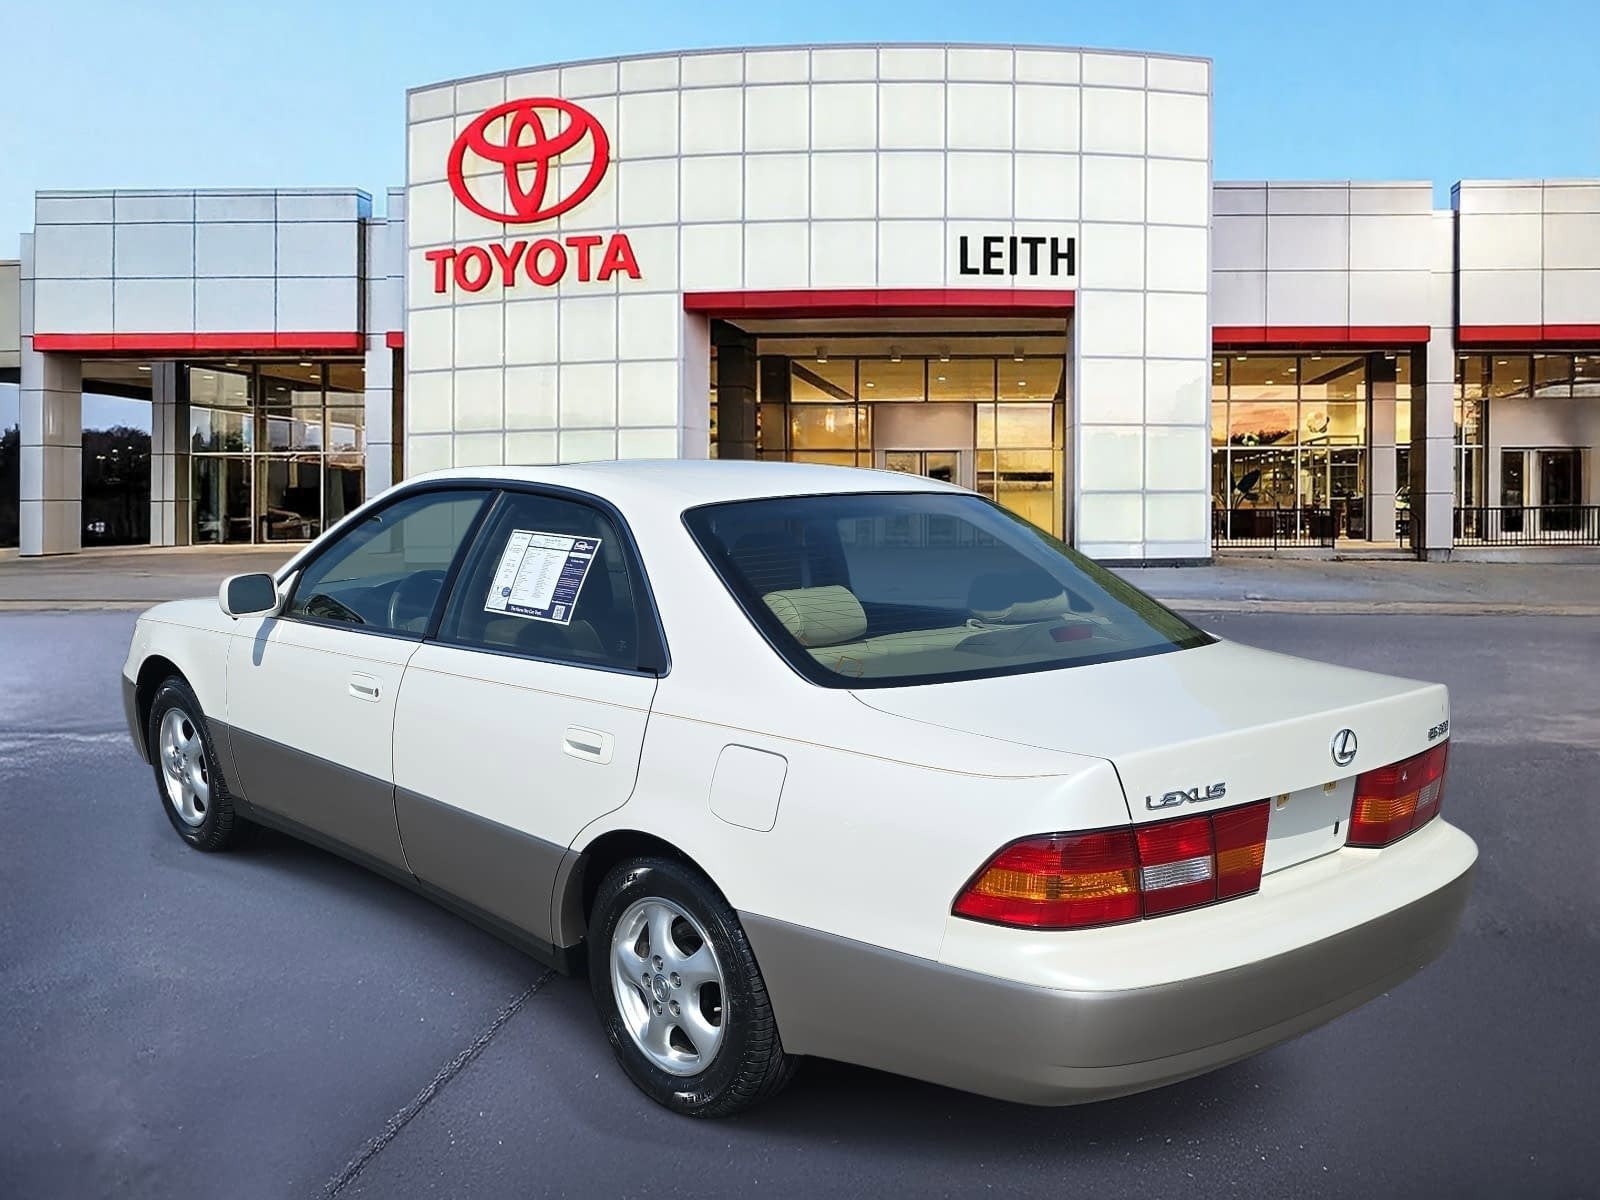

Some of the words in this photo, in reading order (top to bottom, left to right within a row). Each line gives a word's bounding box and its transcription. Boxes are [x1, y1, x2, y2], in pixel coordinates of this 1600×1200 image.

[425, 233, 642, 293] TOYOTA
[959, 235, 1076, 276] LEITH
[1145, 781, 1227, 811] LEXUS
